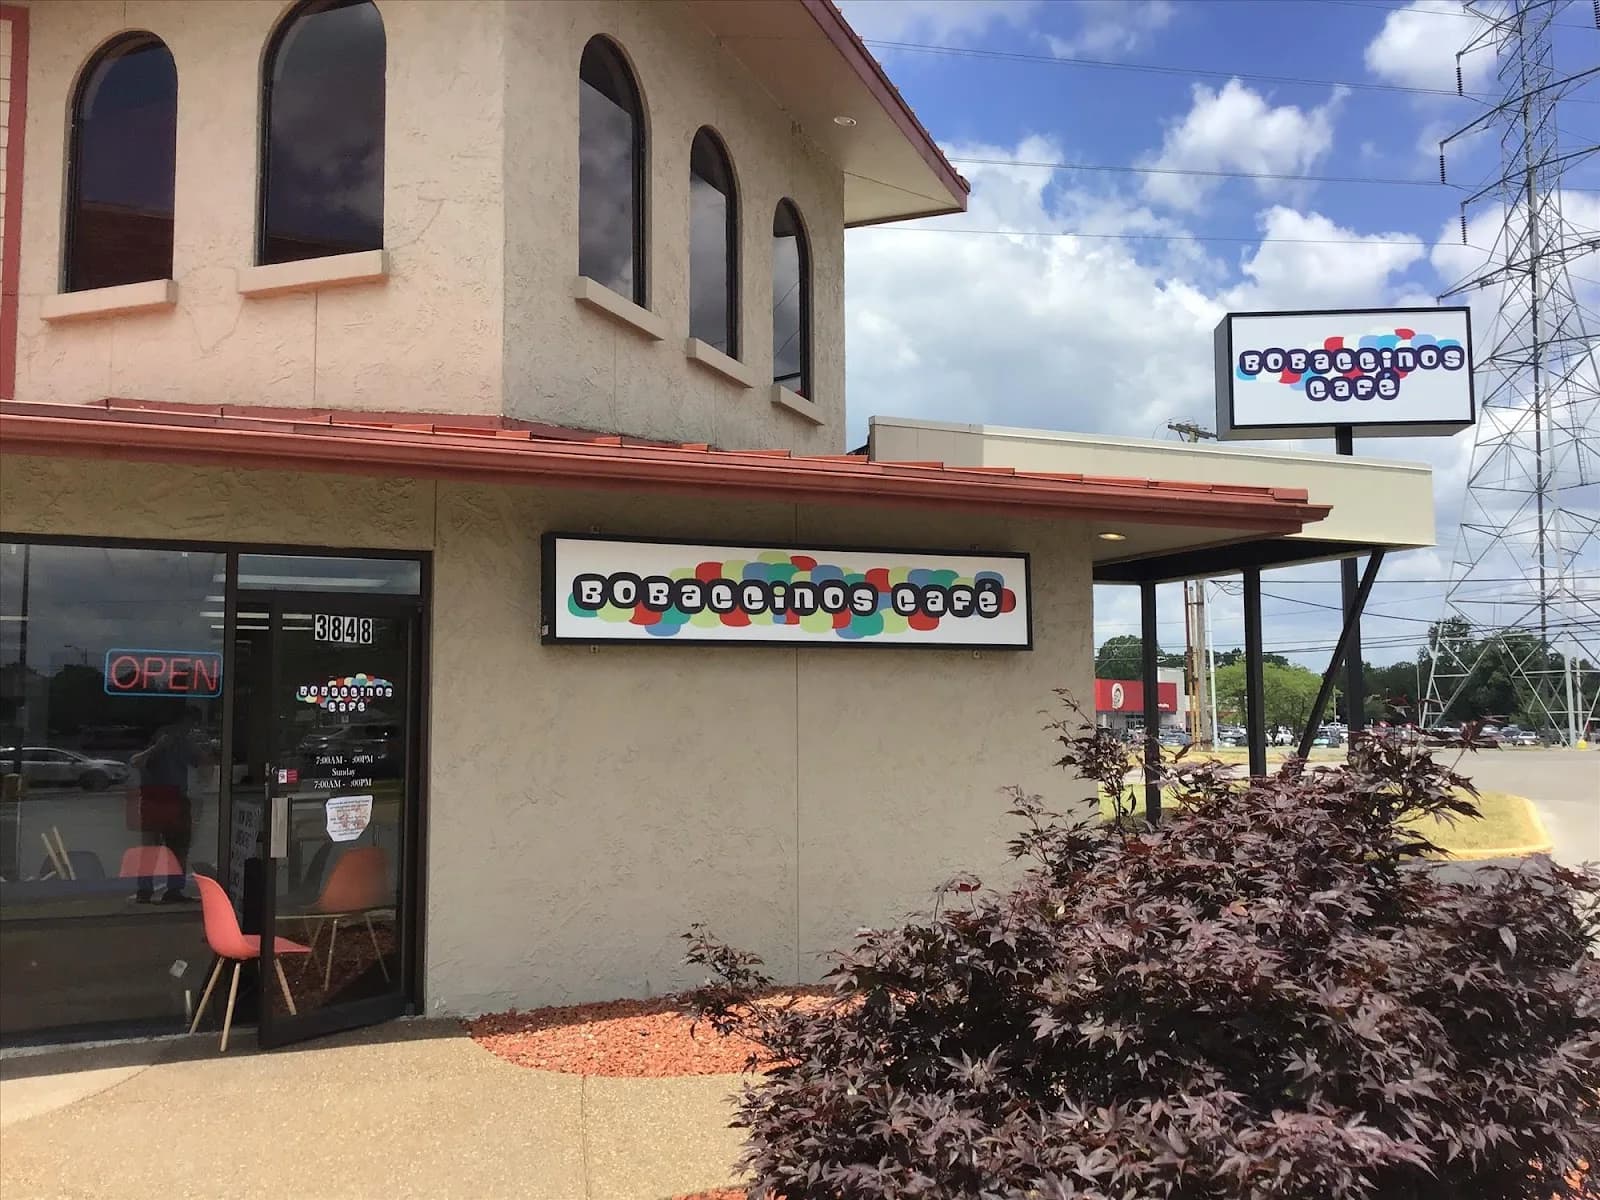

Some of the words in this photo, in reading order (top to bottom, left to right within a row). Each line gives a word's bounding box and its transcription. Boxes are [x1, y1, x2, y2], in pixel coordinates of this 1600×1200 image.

[316, 614, 371, 643] 3848
[110, 655, 219, 691] OPEN
[315, 755, 343, 766] 7:00AM
[331, 767, 356, 778] Sunday
[313, 779, 341, 789] 7:00AM
